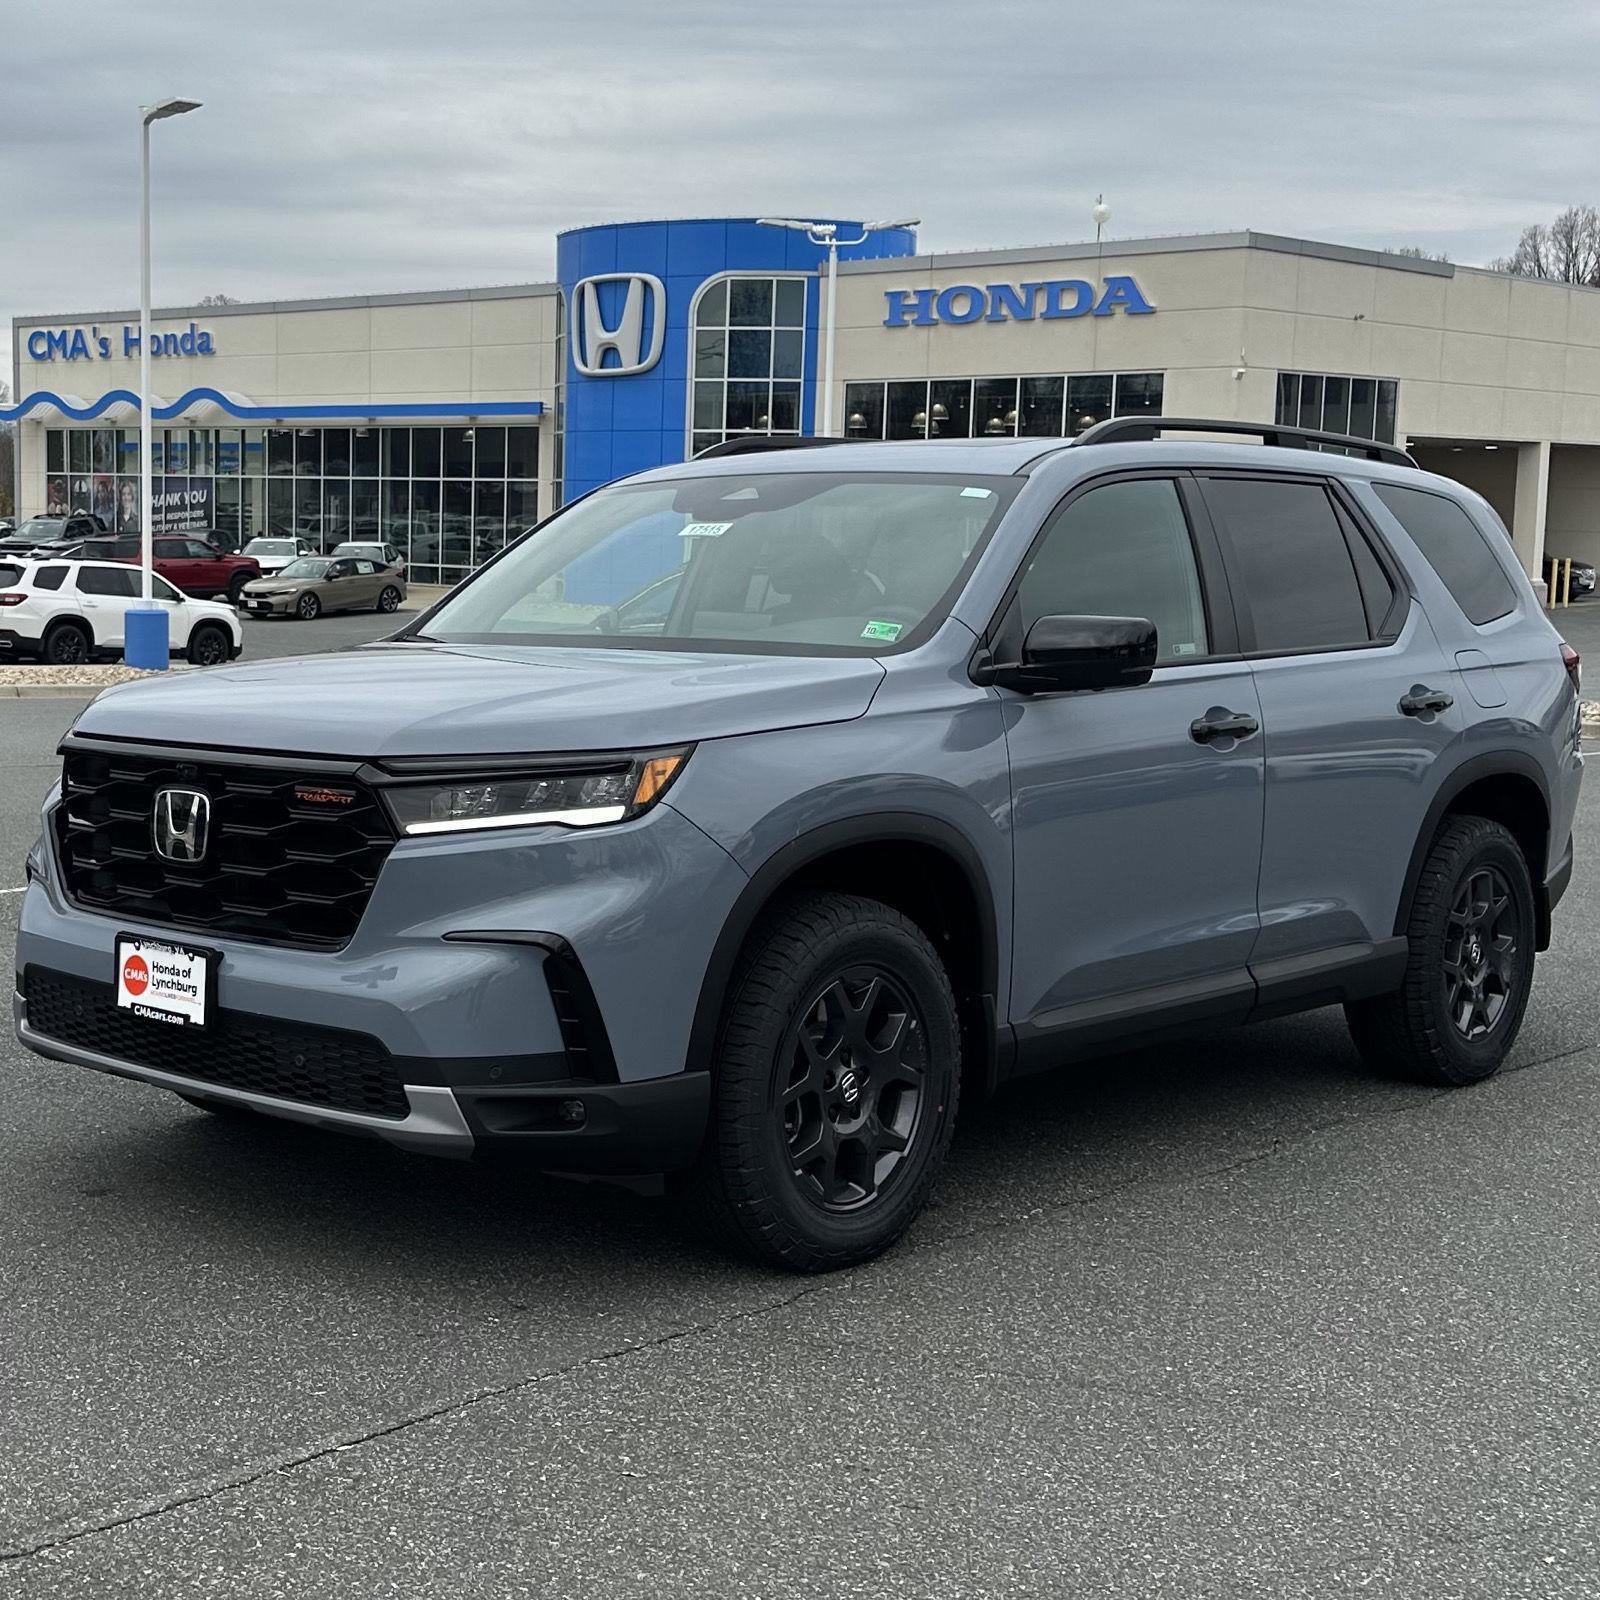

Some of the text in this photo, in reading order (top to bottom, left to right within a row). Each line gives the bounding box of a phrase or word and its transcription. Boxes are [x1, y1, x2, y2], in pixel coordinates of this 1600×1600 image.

[883, 275, 1157, 328] HONDA
[28, 323, 215, 361] CMA's Honda
[151, 489, 207, 508] HANK YOU
[295, 791, 353, 804] TRAILSPORT
[152, 961, 192, 979] Honda of
[152, 975, 198, 996] Lynchburg
[134, 1005, 184, 1025] CMAcars.com
